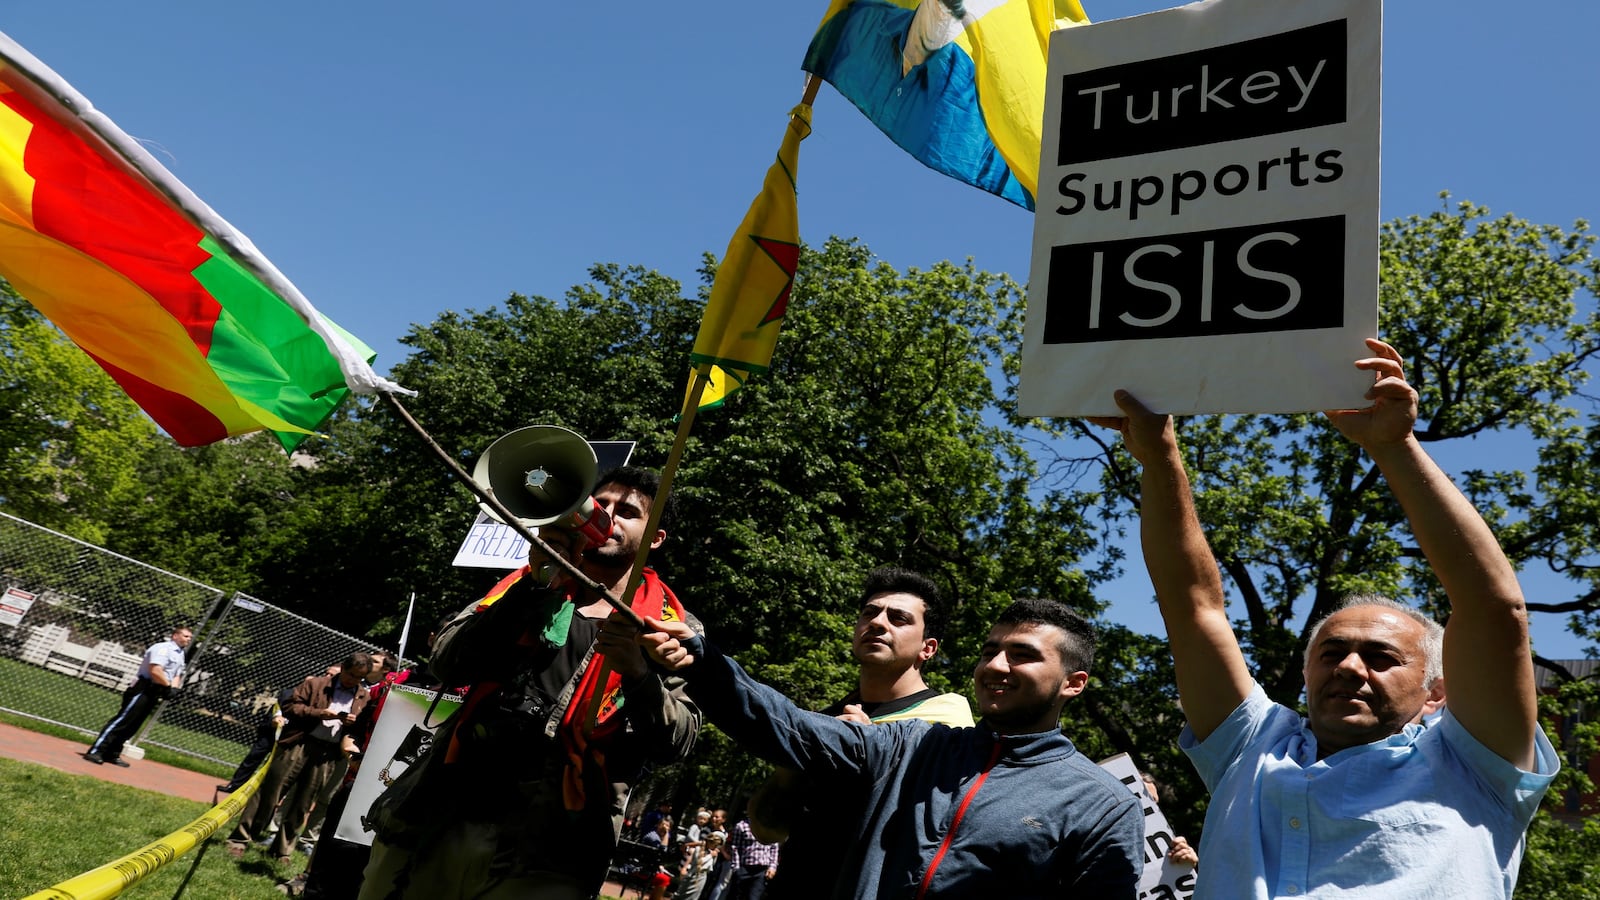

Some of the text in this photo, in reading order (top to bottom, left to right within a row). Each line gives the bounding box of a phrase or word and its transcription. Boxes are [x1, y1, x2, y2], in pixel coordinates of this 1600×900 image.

[1078, 59, 1327, 130] Turkey
[1056, 147, 1344, 220] Supports
[1089, 231, 1302, 329] ISIS
[461, 525, 509, 557] FREE
